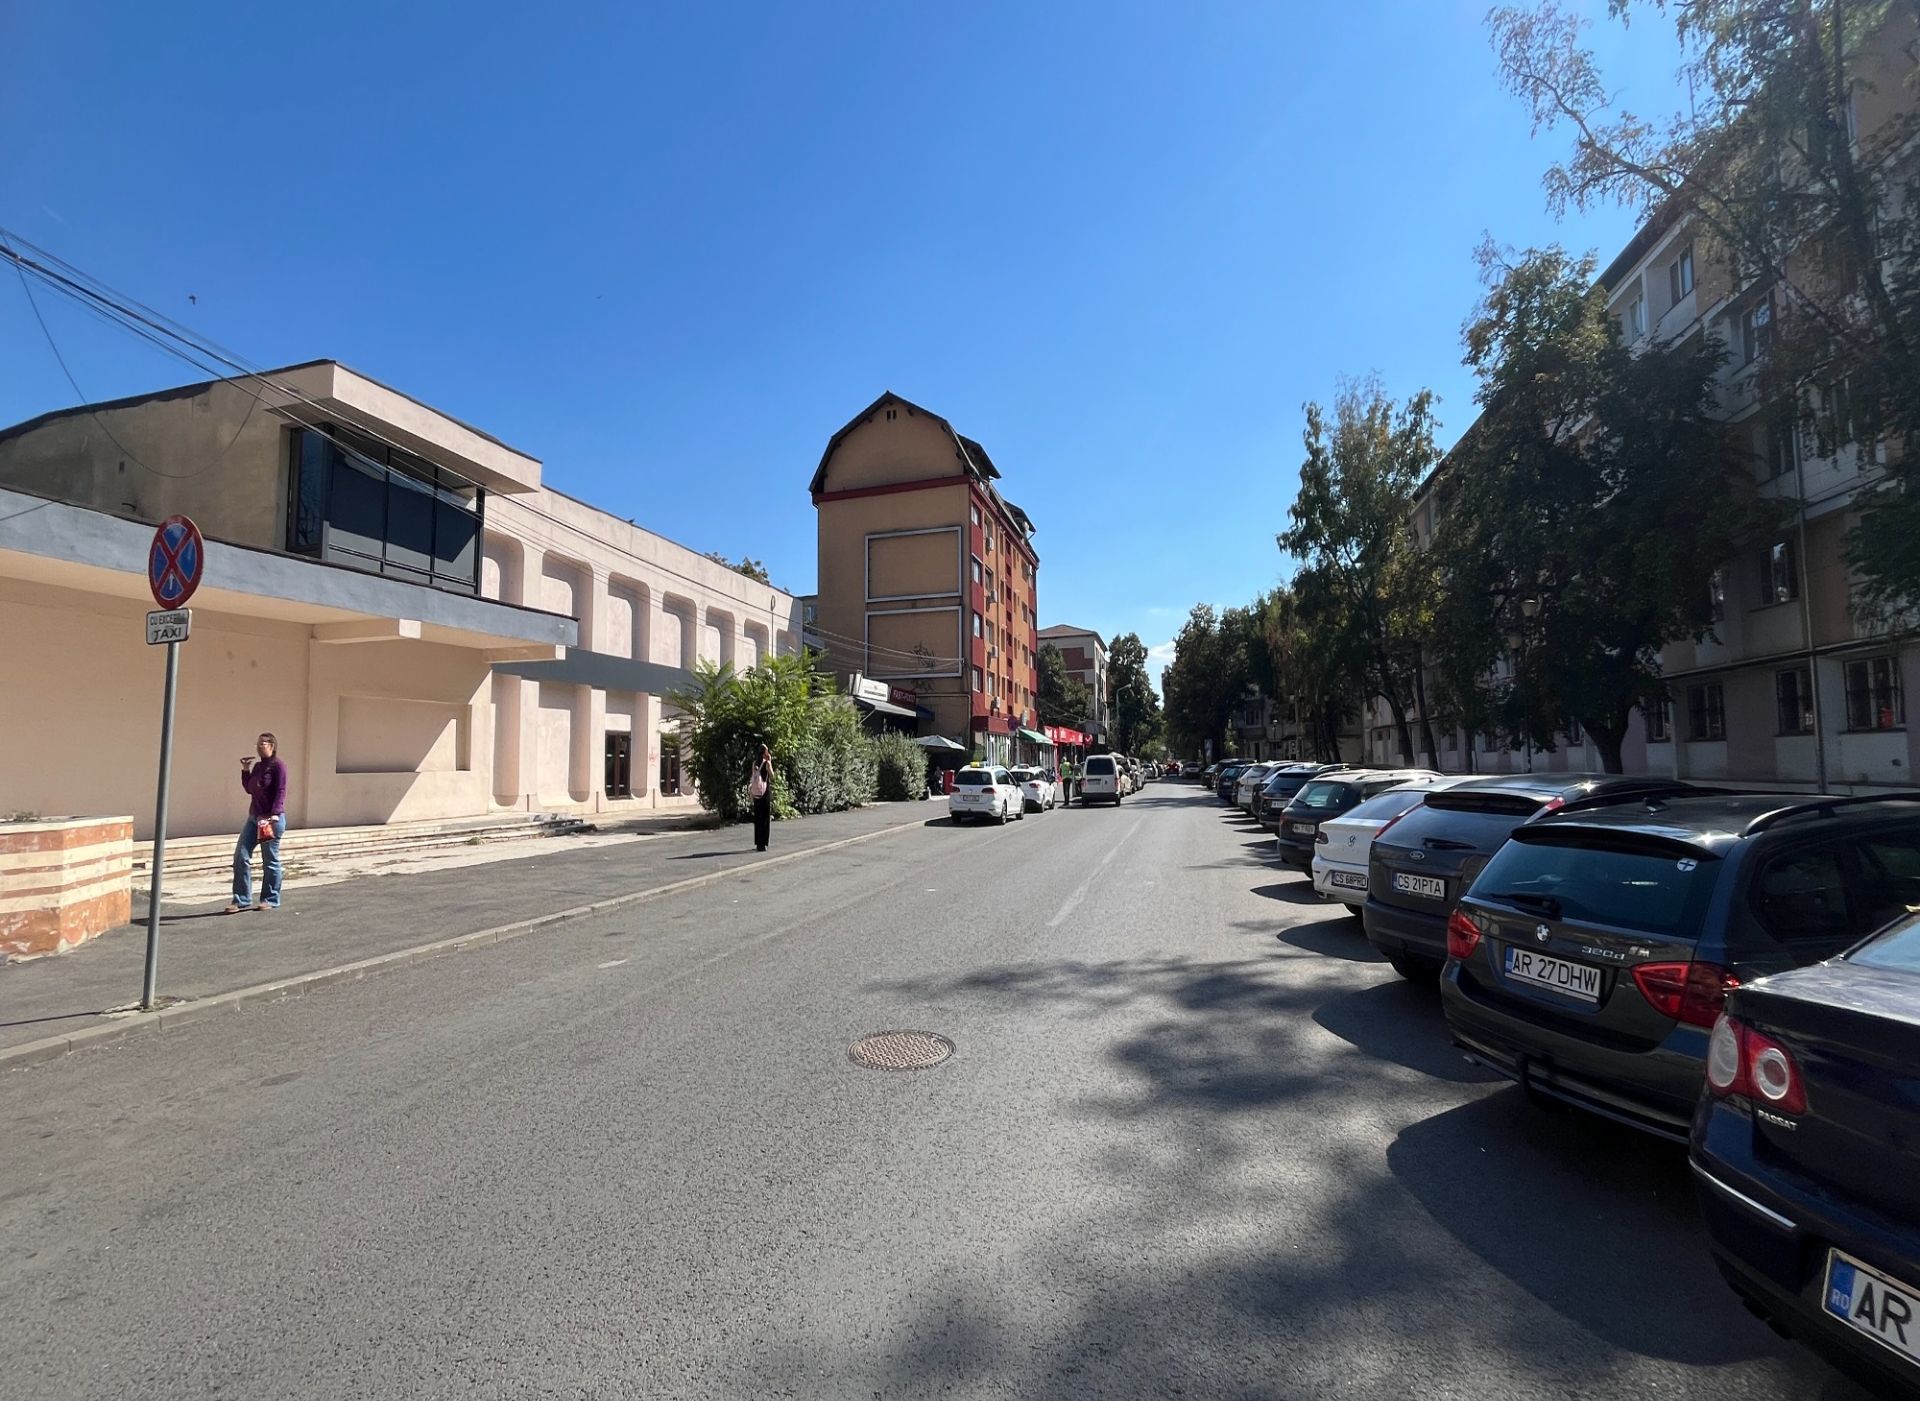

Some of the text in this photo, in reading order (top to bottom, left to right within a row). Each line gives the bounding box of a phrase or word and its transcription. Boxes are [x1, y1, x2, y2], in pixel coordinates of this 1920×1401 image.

[153, 627, 182, 641] TAXI
[1335, 873, 1345, 883] CS
[1397, 875, 1442, 895] CS 21PTA
[1512, 952, 1532, 974] AR
[1581, 945, 1625, 960] 320d
[1758, 1109, 1798, 1131] PASSAT
[1830, 1287, 1850, 1310] RO
[1854, 1281, 1913, 1346] AR
